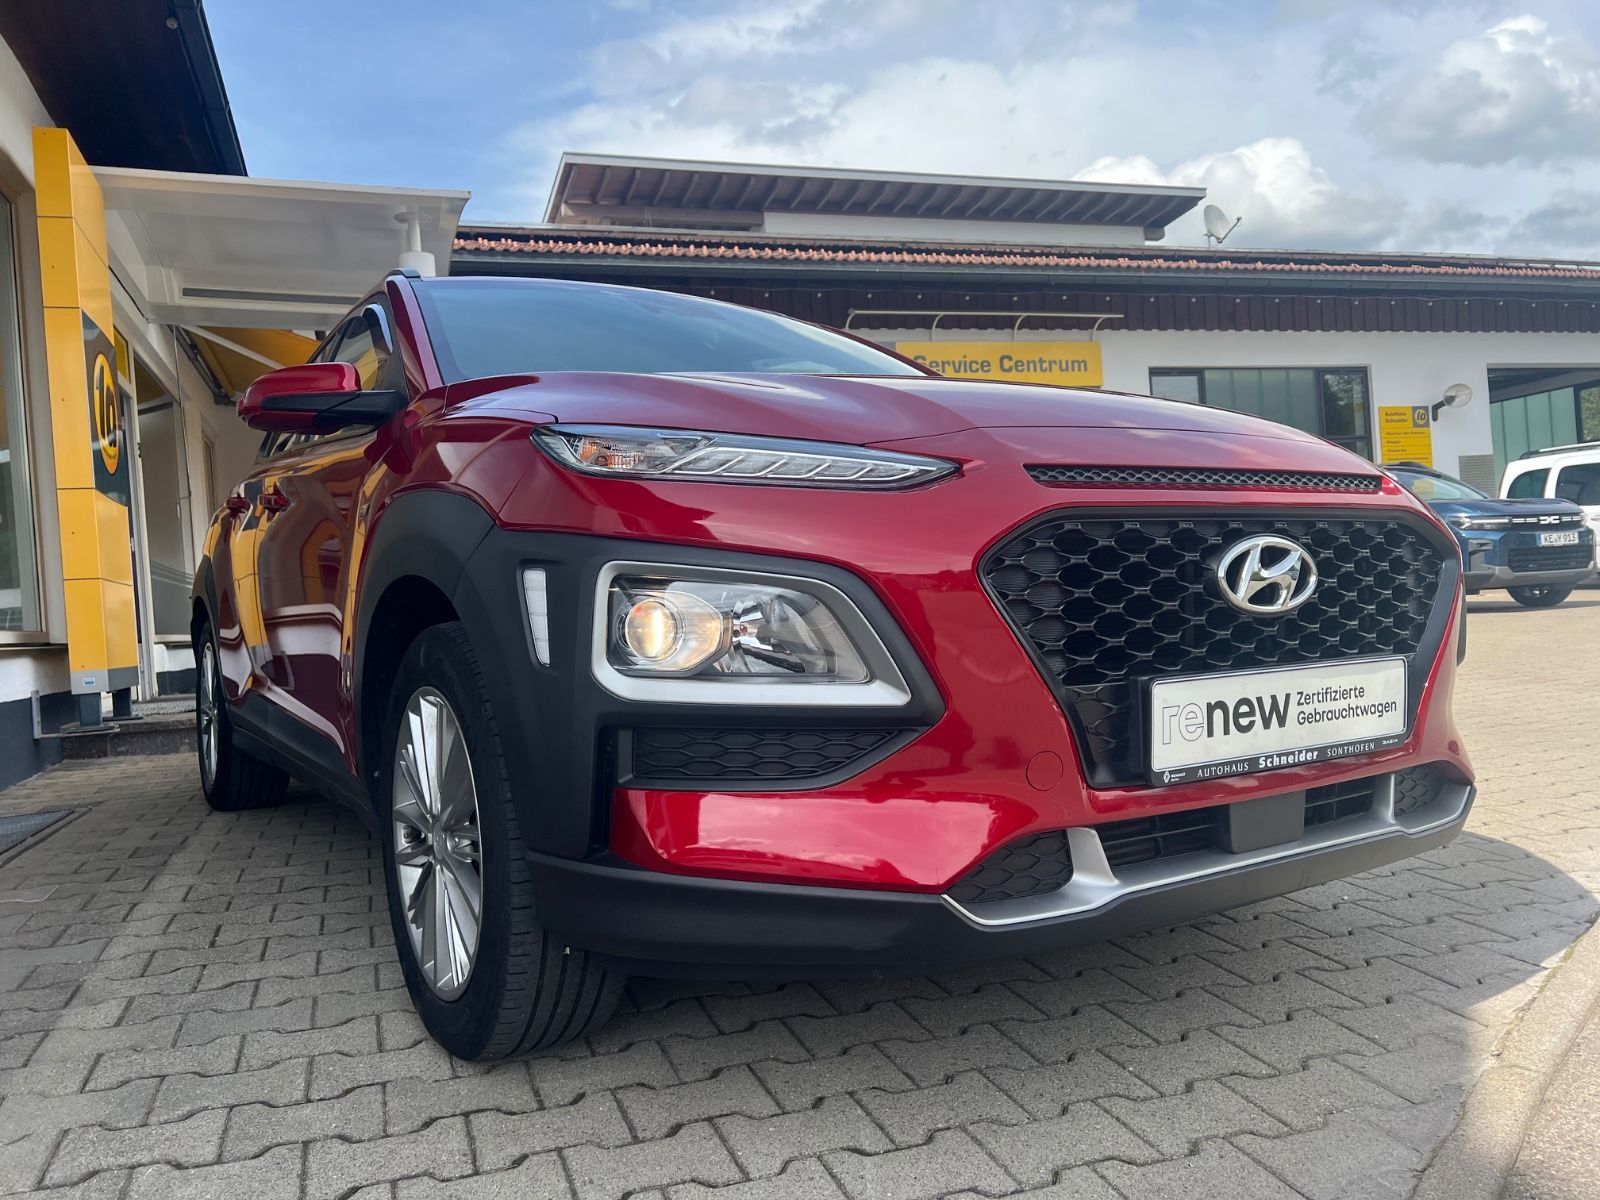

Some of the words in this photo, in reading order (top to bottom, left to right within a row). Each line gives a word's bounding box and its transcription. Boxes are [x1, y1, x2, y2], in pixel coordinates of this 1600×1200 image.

[999, 354, 1088, 373] Centrum
[1544, 533, 1554, 544] KE
[1563, 532, 1576, 543] 913
[1162, 693, 1291, 745] renew
[1296, 685, 1365, 707] Zertifizierte
[1297, 699, 1397, 726] Gebrauchtwagen
[1197, 762, 1249, 778] AUTOHAUS
[1258, 751, 1319, 769] Schneider
[1327, 742, 1375, 757] SONTHOFEN
